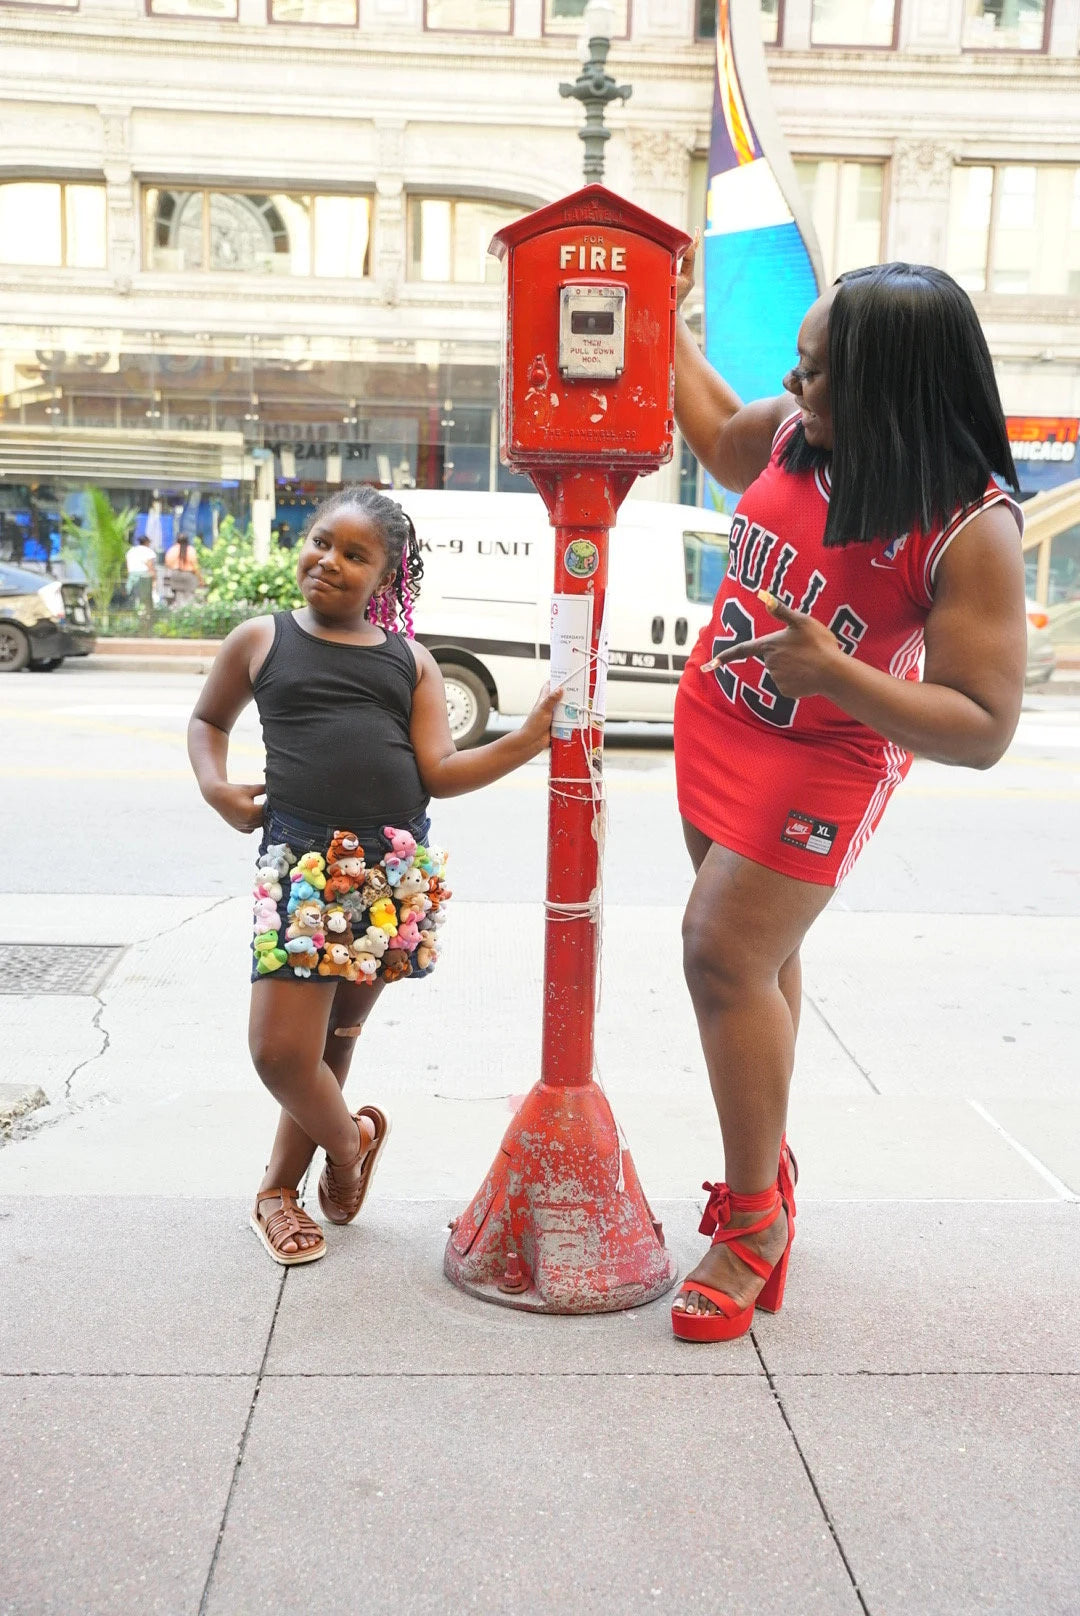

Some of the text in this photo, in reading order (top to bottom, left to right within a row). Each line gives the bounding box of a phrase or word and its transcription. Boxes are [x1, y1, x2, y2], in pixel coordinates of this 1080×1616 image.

[583, 235, 604, 244] FOR
[559, 245, 627, 272] FIRE
[575, 288, 615, 296] OPEN
[583, 339, 602, 347] THEN
[1009, 441, 1075, 461] HICAGO
[419, 538, 534, 556] K-9 UNIT
[632, 653, 656, 668] K9
[816, 824, 831, 838] XL
